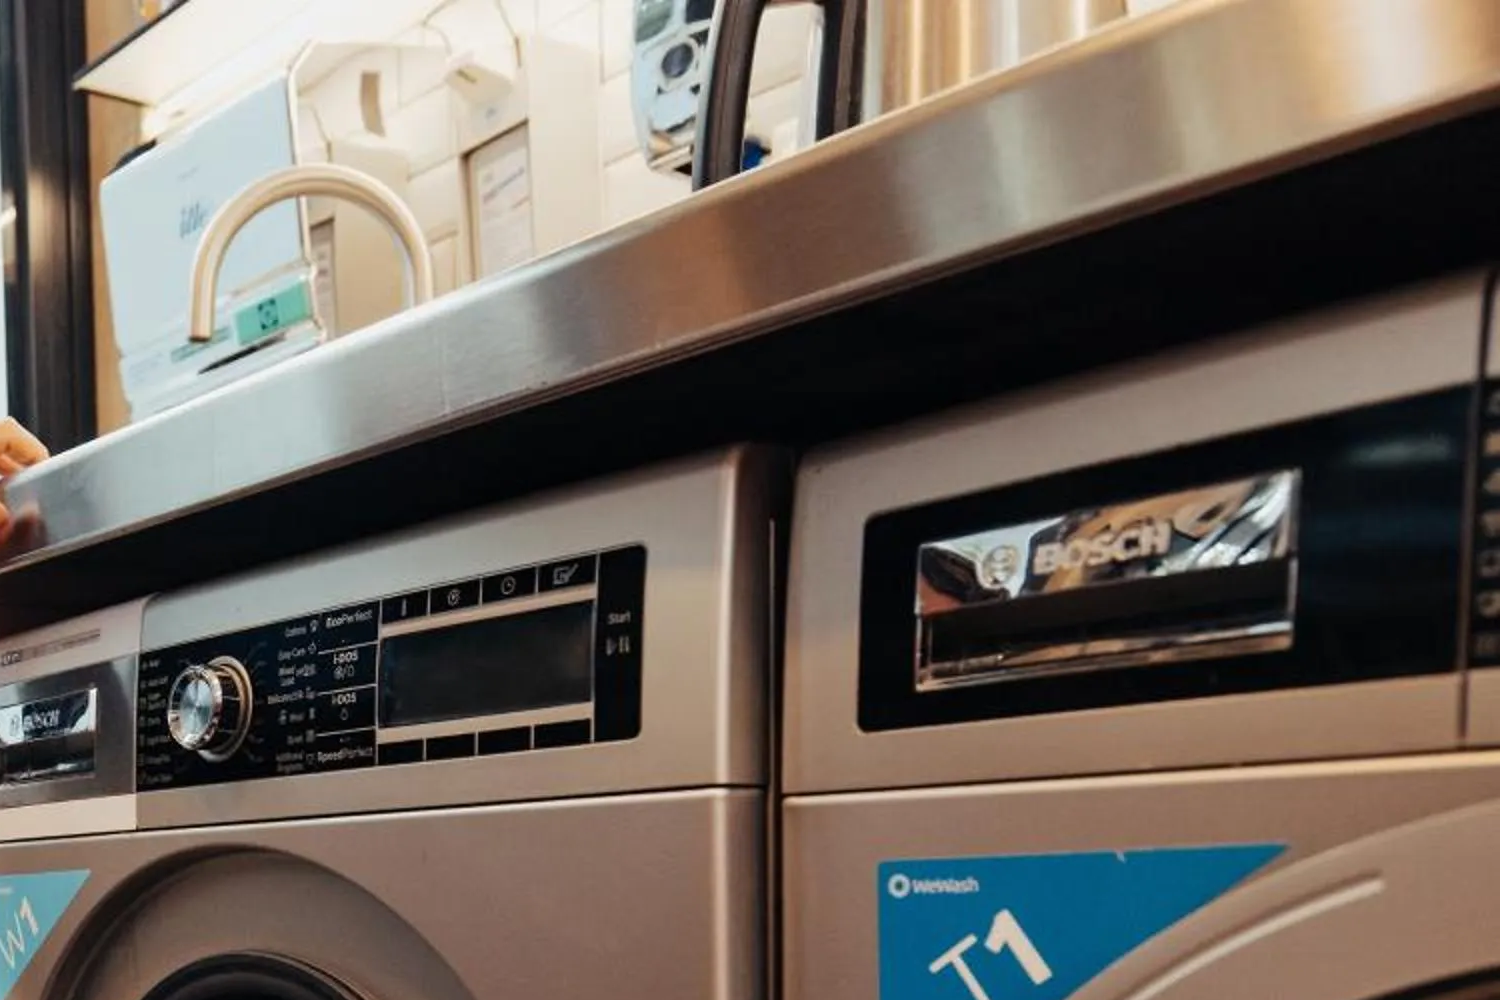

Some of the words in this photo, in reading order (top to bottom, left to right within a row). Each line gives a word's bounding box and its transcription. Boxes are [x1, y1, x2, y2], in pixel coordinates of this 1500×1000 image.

[1032, 521, 1172, 575] BOSCH
[326, 609, 373, 629] EcoPerfect
[911, 876, 980, 894] WeWash
